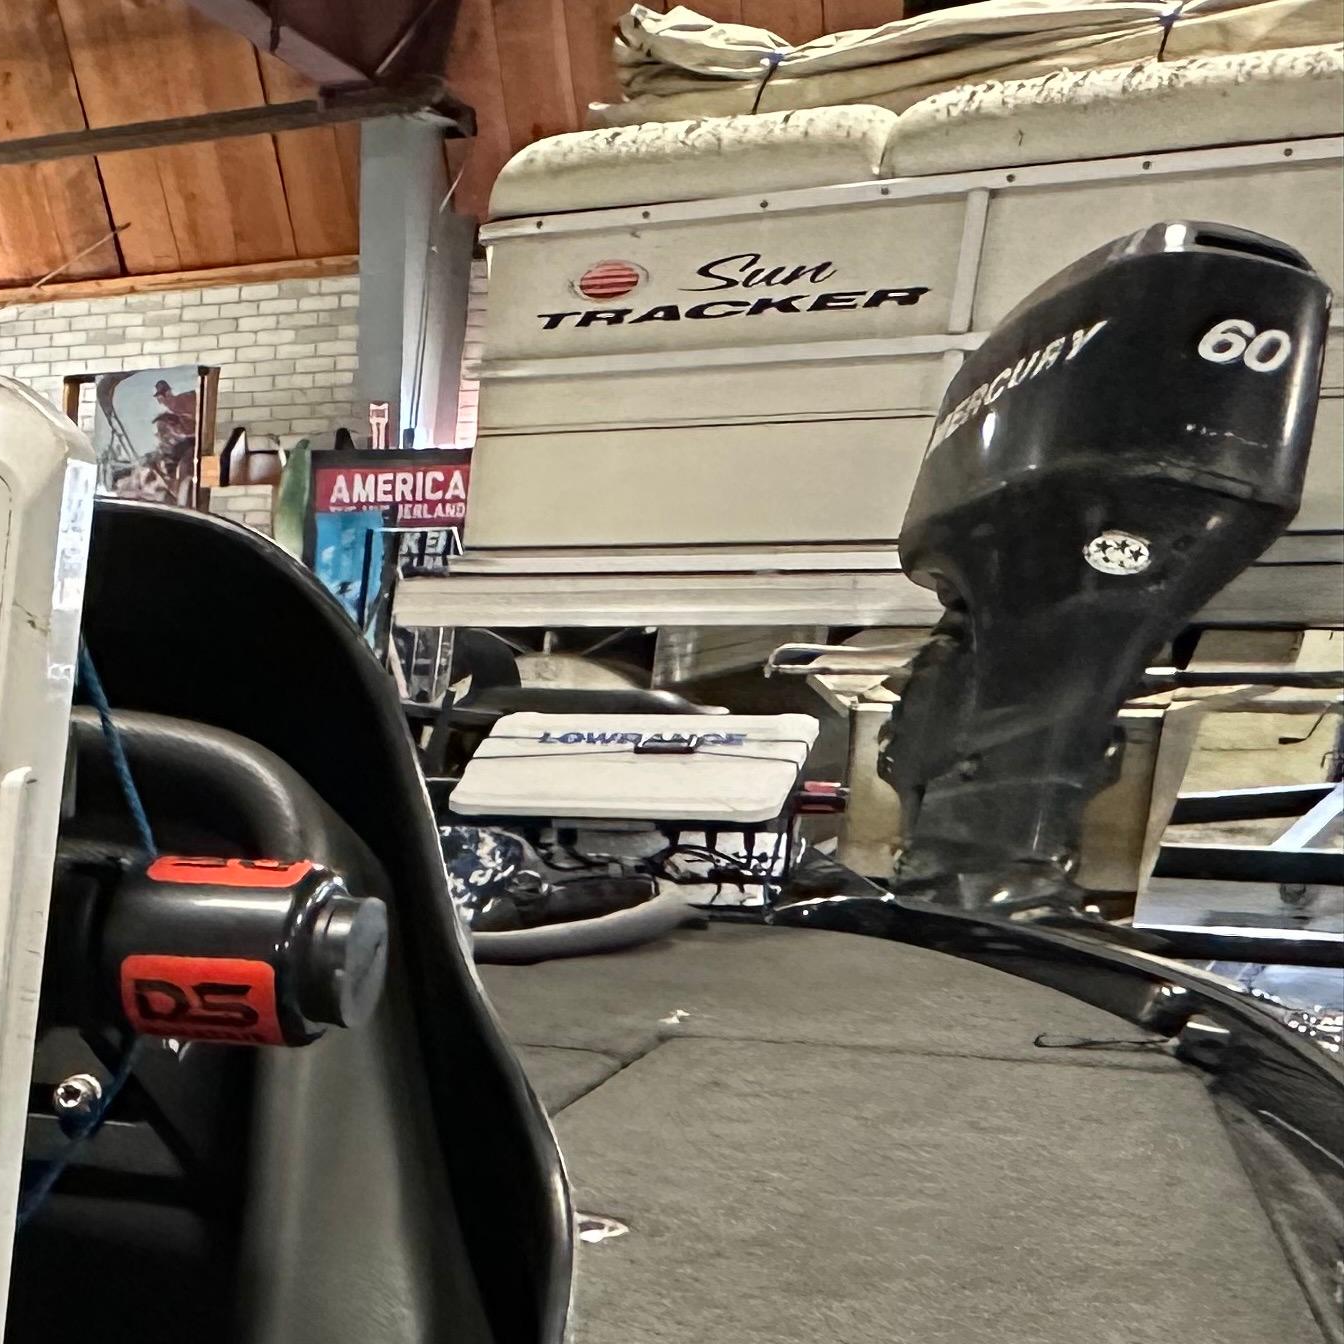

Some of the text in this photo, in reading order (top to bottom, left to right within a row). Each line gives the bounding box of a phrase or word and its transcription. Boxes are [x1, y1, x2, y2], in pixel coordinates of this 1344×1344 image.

[678, 253, 838, 292] Sun
[537, 286, 932, 330] TRACKER
[1198, 318, 1292, 373] 60
[329, 470, 466, 503] AMERICA
